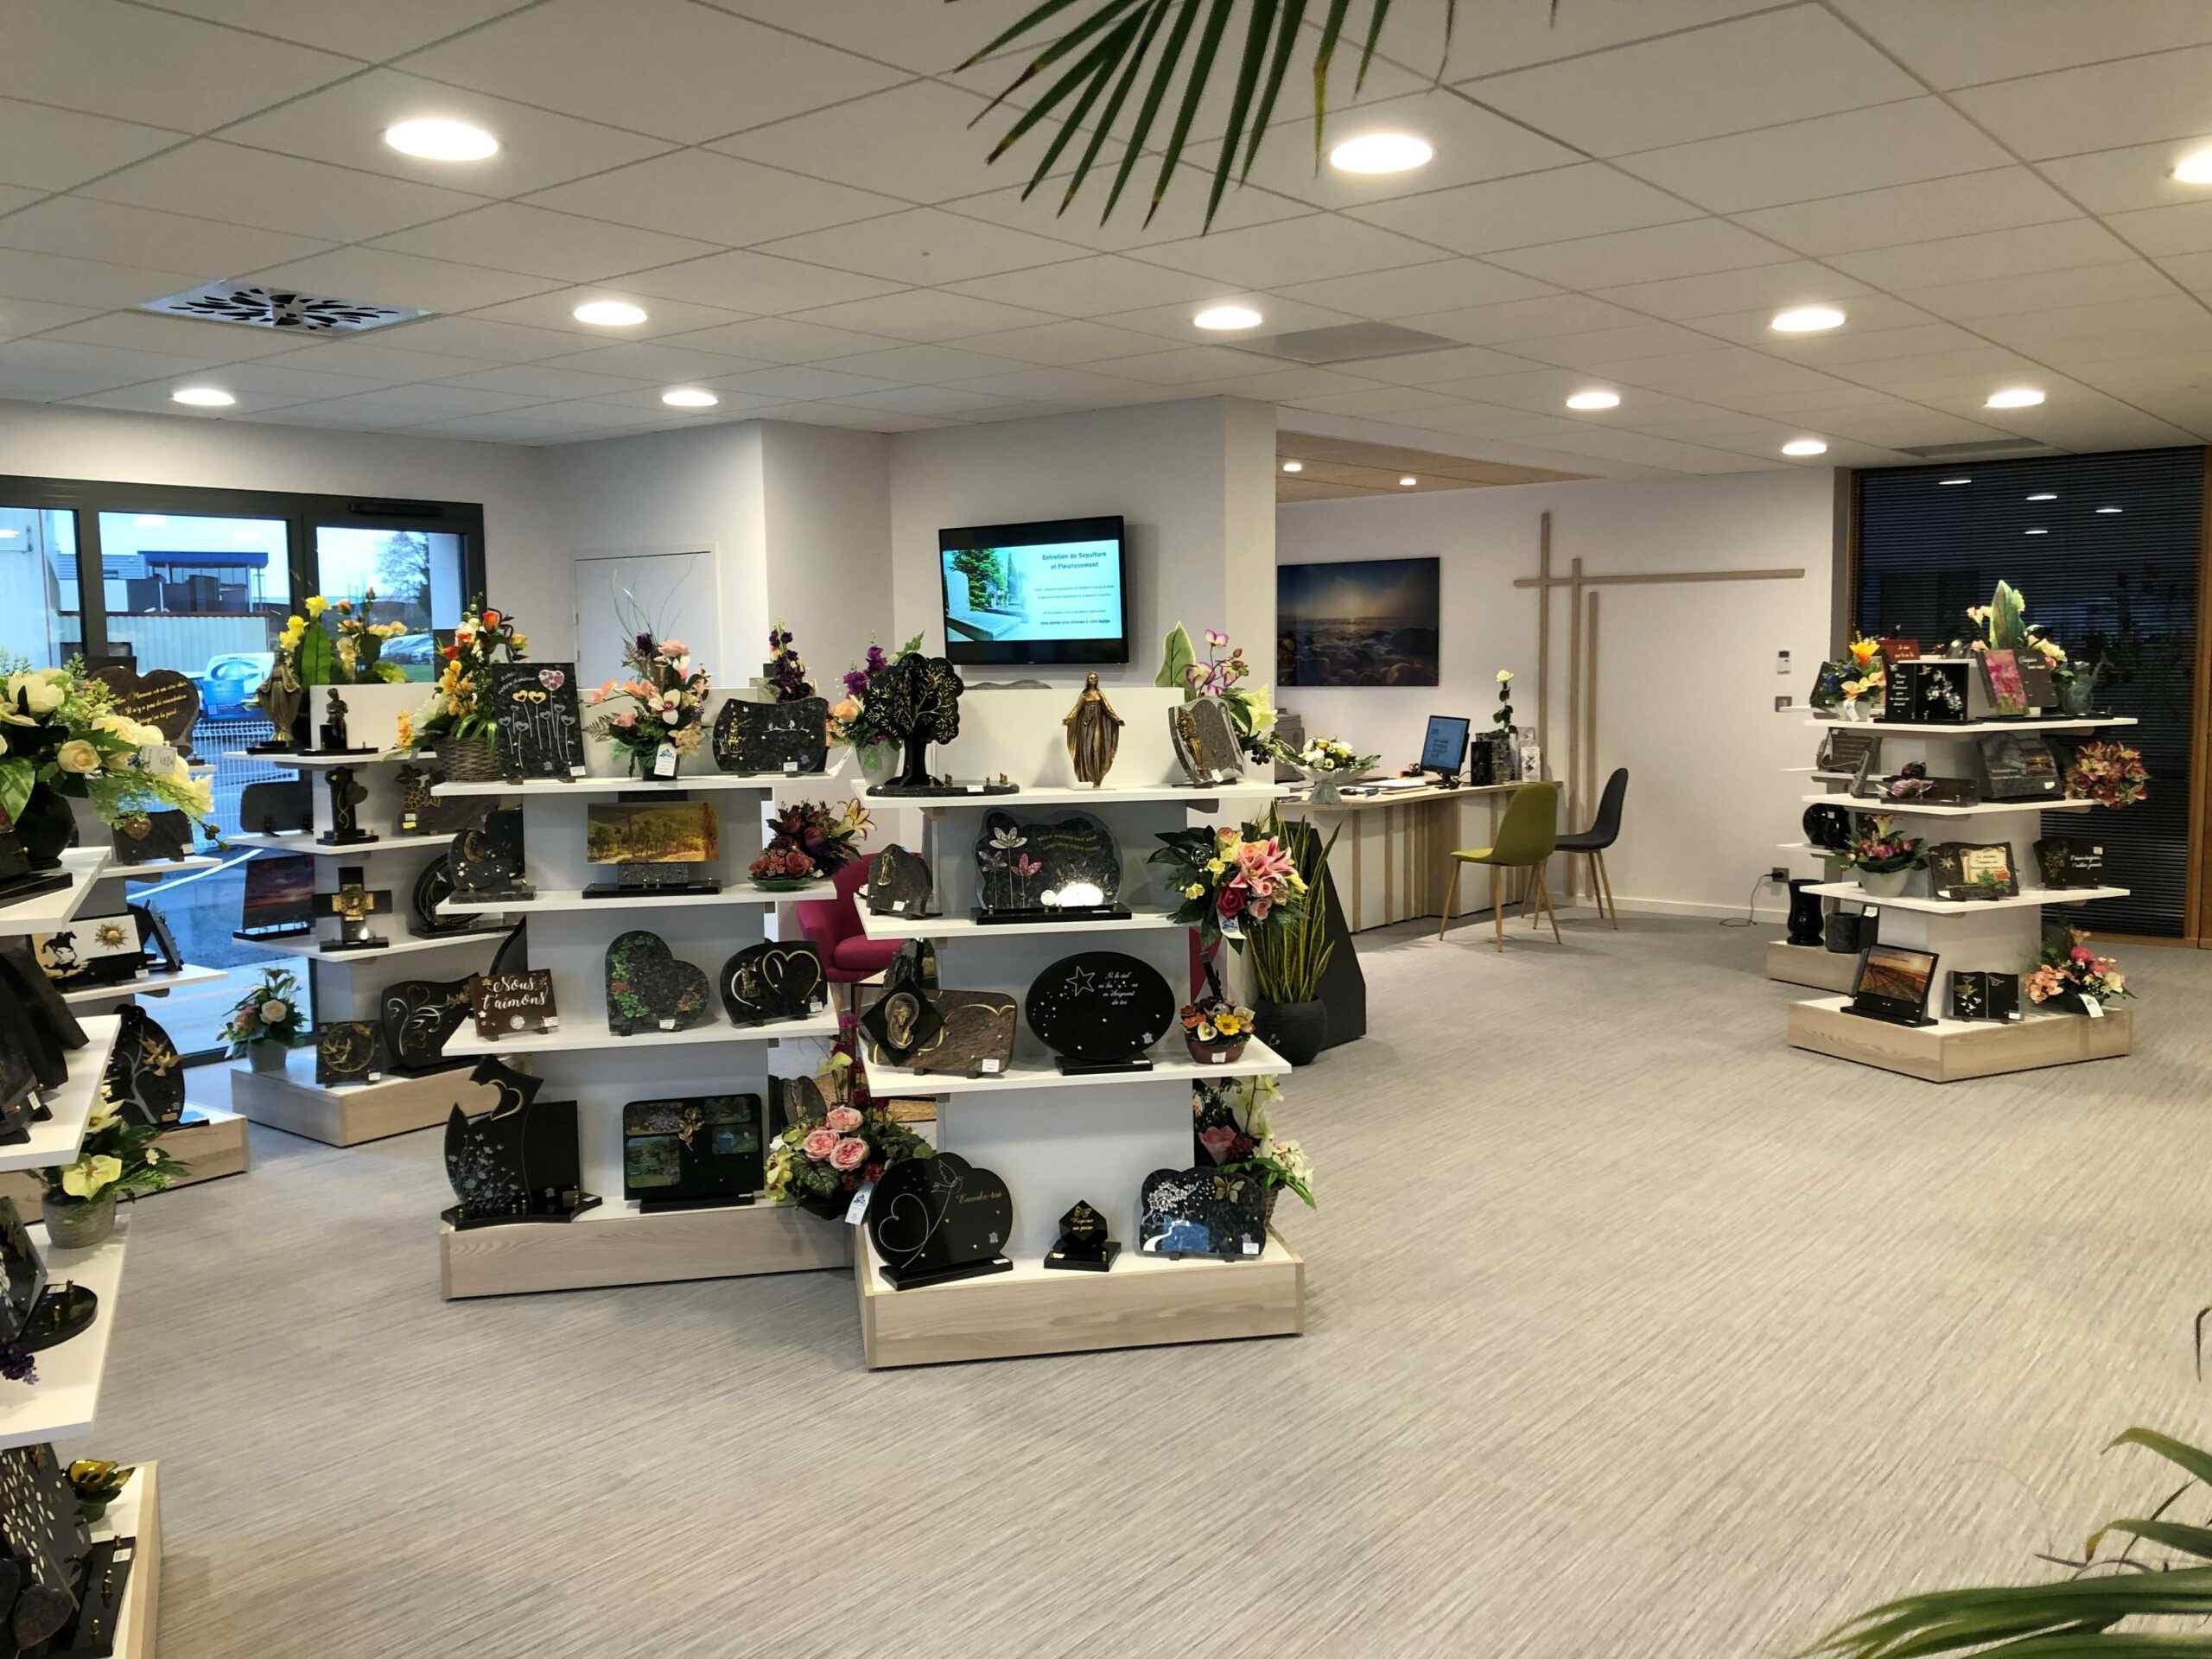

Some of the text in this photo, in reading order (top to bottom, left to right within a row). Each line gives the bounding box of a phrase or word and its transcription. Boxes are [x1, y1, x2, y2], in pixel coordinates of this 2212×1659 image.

[1058, 562, 1099, 570] Fleurissement
[487, 975, 534, 993] Nous
[482, 992, 546, 1010] t'aimons
